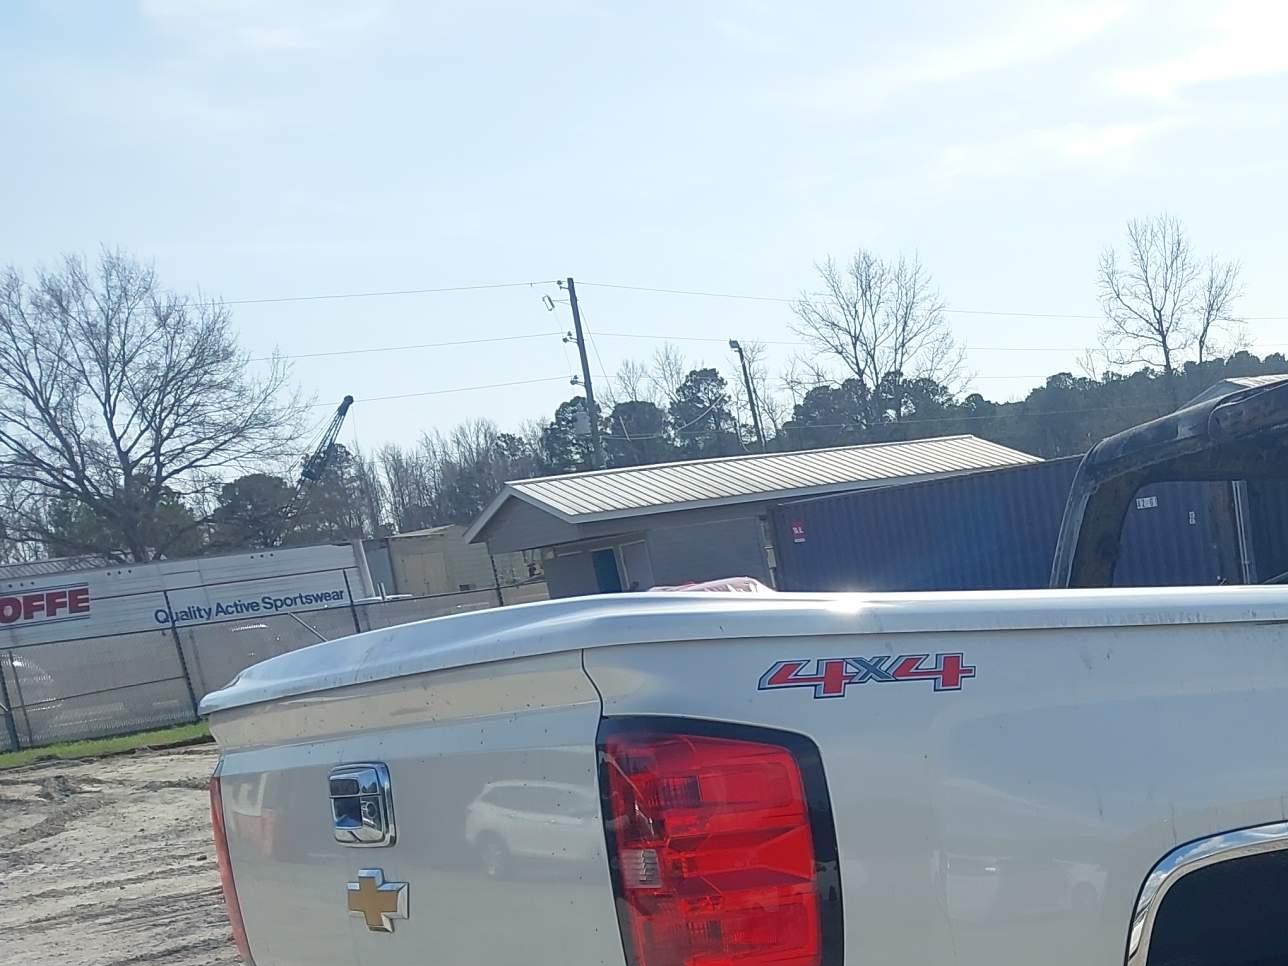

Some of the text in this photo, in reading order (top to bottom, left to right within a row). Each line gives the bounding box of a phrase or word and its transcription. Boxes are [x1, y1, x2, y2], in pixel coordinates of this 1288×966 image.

[154, 590, 345, 624] Quality Active Sportswear
